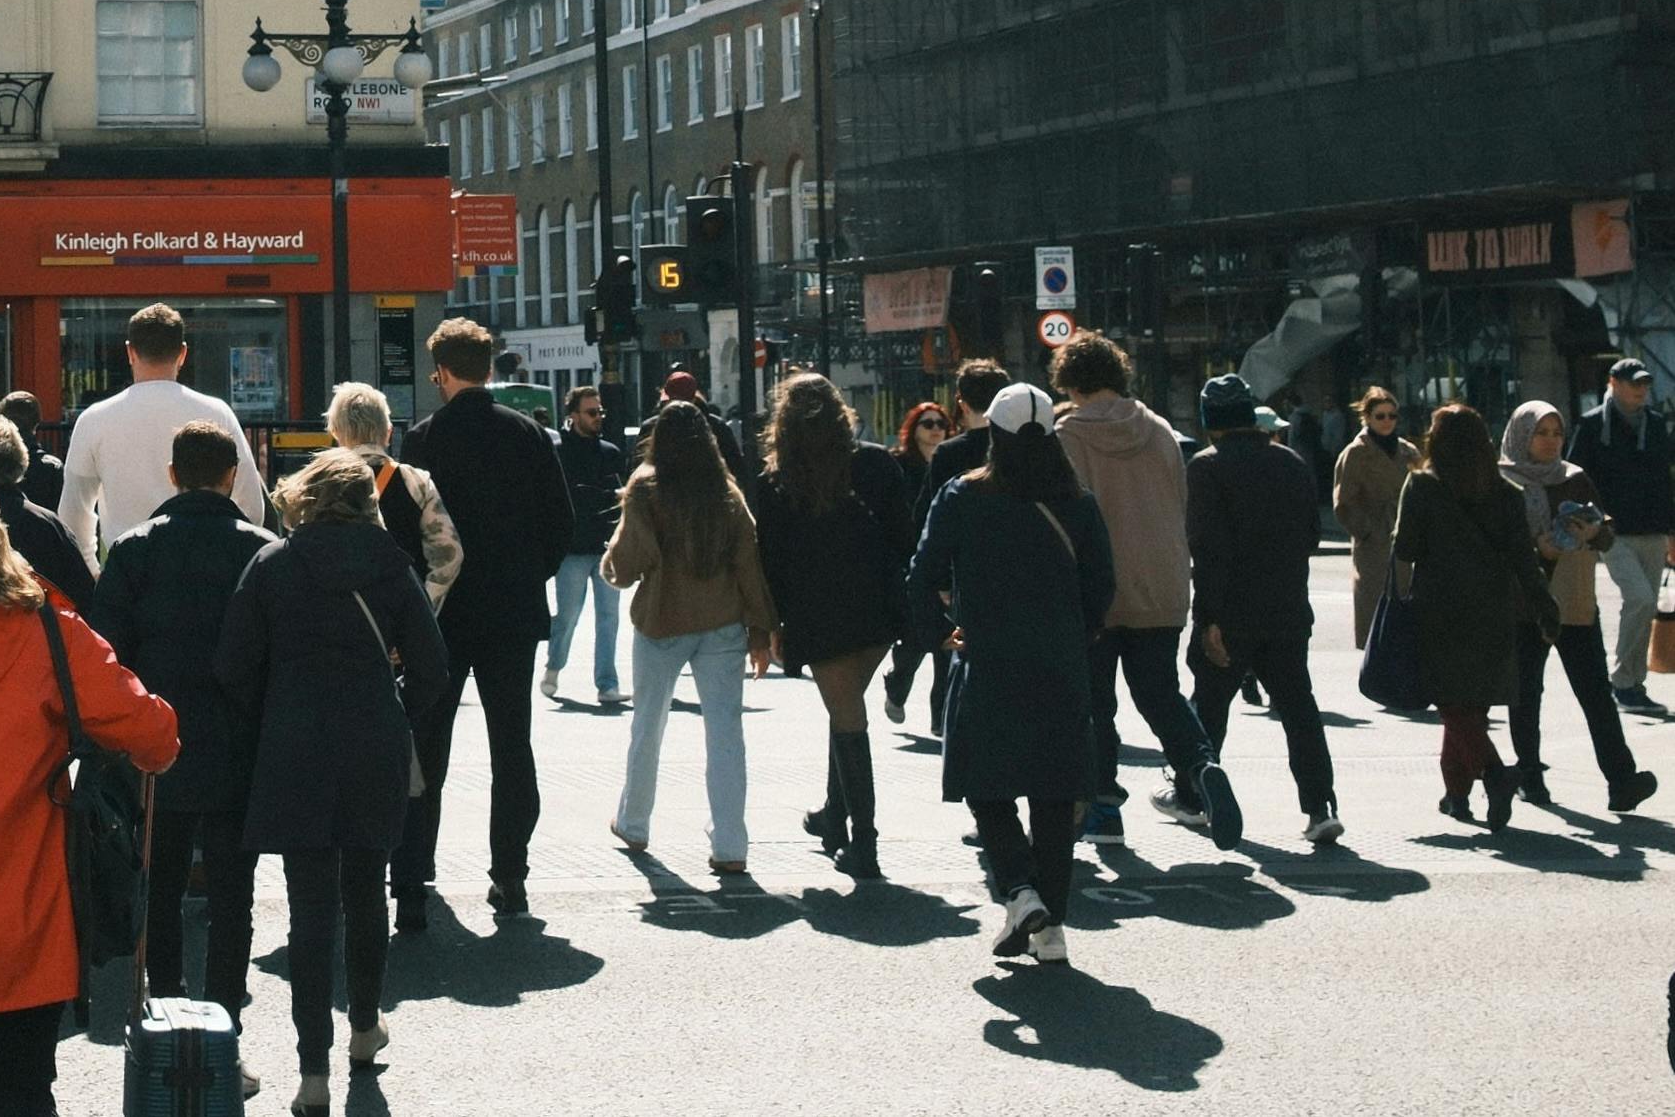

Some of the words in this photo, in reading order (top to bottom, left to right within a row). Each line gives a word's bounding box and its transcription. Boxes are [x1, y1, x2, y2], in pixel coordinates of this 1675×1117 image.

[357, 97, 381, 109] NW1
[55, 232, 128, 254] Kinleigh
[133, 231, 199, 250] Folkard
[203, 232, 219, 250] &
[223, 230, 304, 253] Hayward
[462, 250, 515, 262] kfh.co.uk
[660, 262, 680, 288] 15
[1044, 321, 1069, 337] 20
